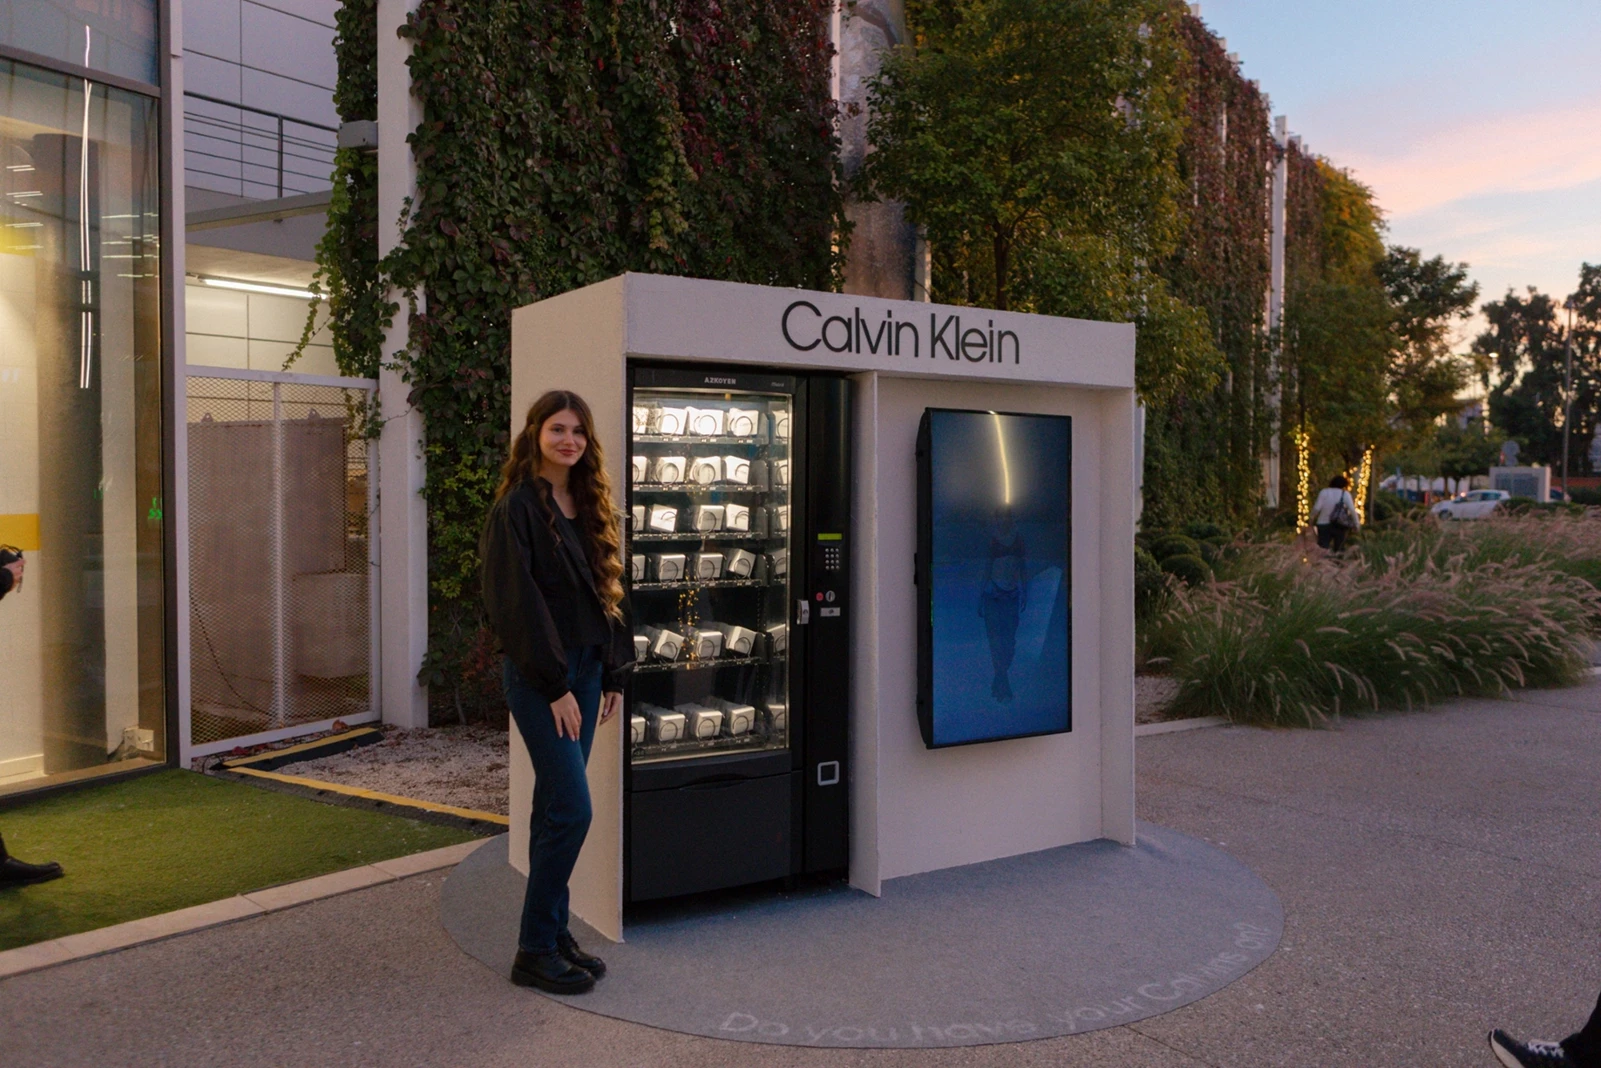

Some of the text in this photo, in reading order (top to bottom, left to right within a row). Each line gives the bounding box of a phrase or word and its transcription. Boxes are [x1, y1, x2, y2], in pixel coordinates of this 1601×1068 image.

[781, 300, 1020, 364] Calvin Klein
[704, 376, 737, 385] AZKOYEN
[719, 1011, 789, 1036] Do
[805, 1025, 898, 1044] you
[911, 1020, 1036, 1042] have
[1046, 996, 1143, 1030] your
[1137, 951, 1249, 1000] Calvins
